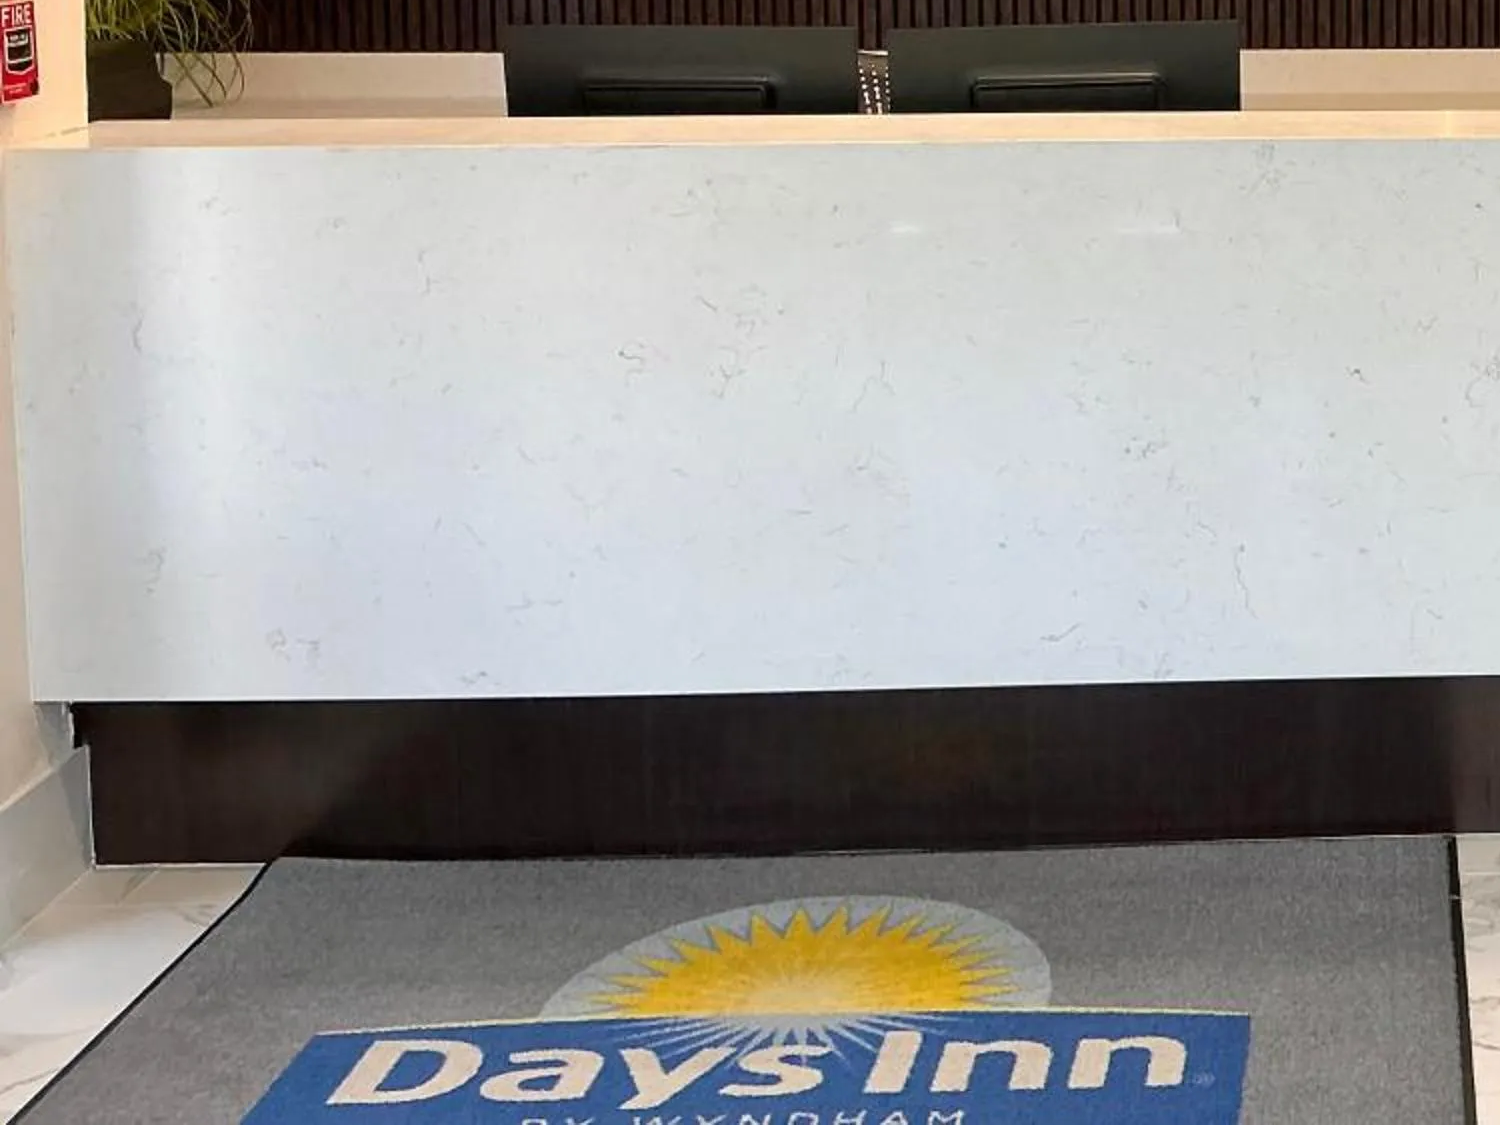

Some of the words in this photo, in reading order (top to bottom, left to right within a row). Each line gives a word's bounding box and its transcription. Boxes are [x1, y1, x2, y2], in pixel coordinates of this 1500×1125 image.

[1, 2, 32, 28] FIRE
[325, 1039, 834, 1110] Days
[862, 1029, 1187, 1094] Inn
